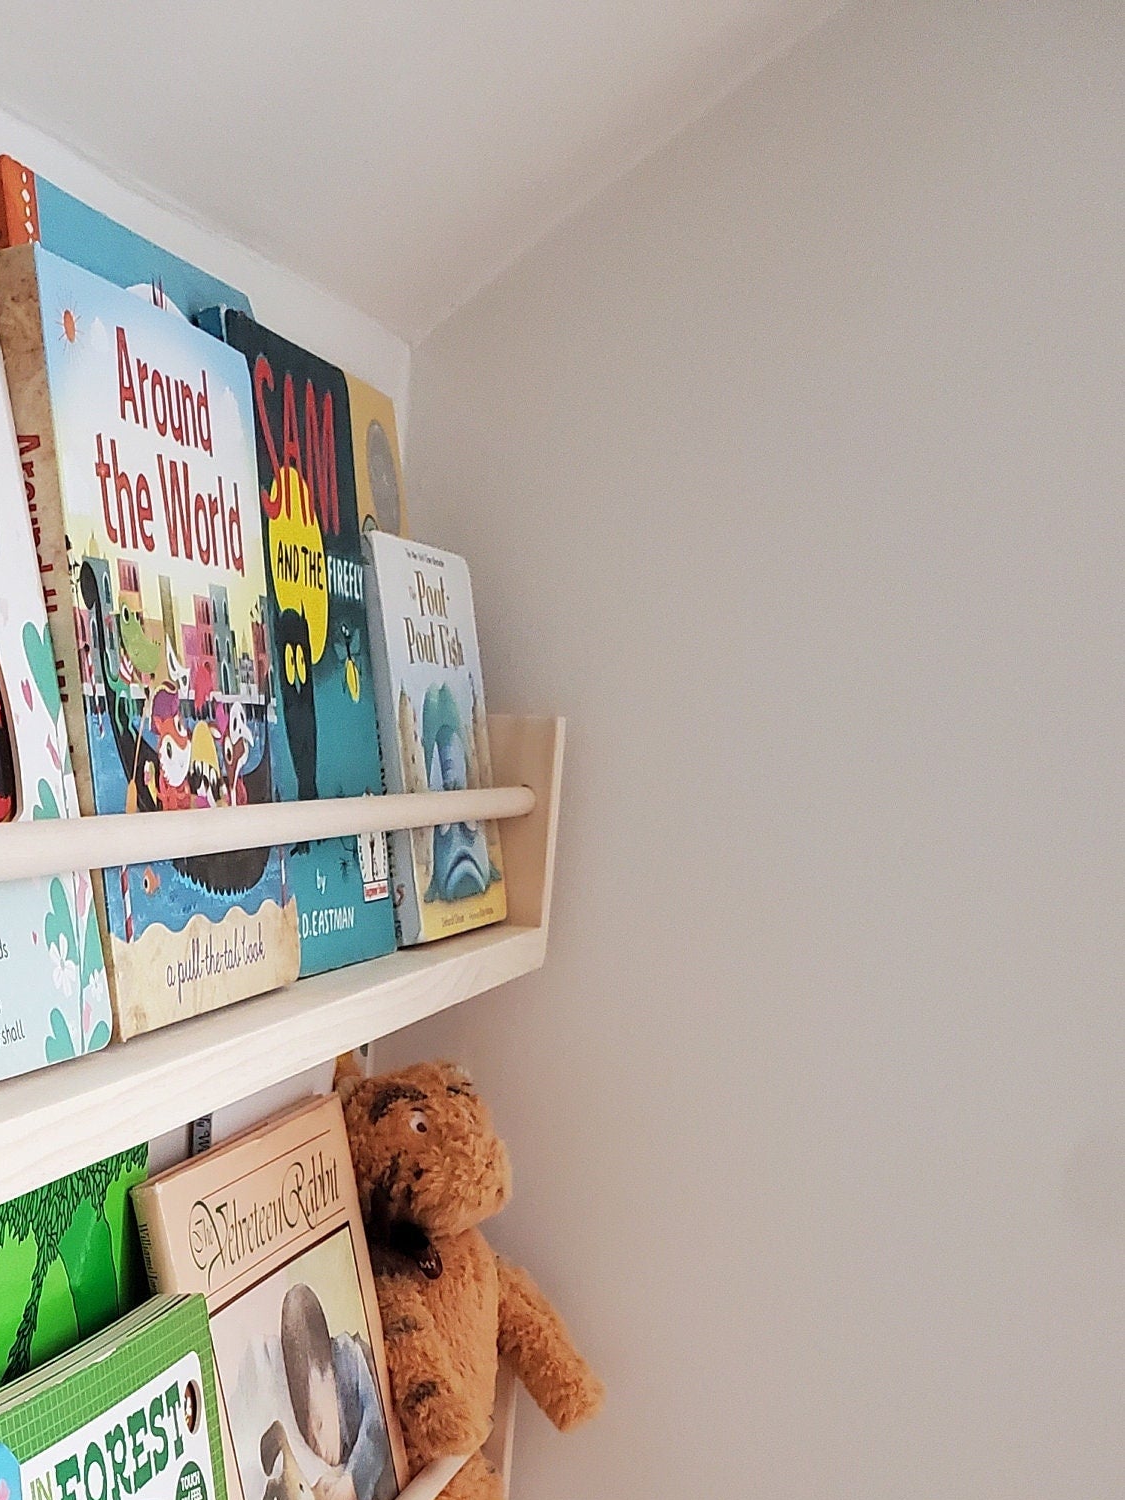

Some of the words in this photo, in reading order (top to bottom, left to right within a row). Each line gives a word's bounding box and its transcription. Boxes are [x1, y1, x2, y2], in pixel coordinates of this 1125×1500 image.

[116, 324, 213, 458] Around
[253, 351, 340, 536] SAM
[94, 432, 155, 553] the
[156, 453, 245, 578] World
[277, 540, 300, 584] AND
[301, 545, 323, 591] THE
[327, 555, 363, 601] FIREFLY
[403, 616, 440, 665] Pout
[316, 867, 327, 895] by
[166, 964, 176, 988] a
[241, 922, 266, 966] book
[189, 1198, 283, 1290] Velveteen
[282, 1151, 340, 1230] Rabbit
[180, 1470, 201, 1491] TOUCH
